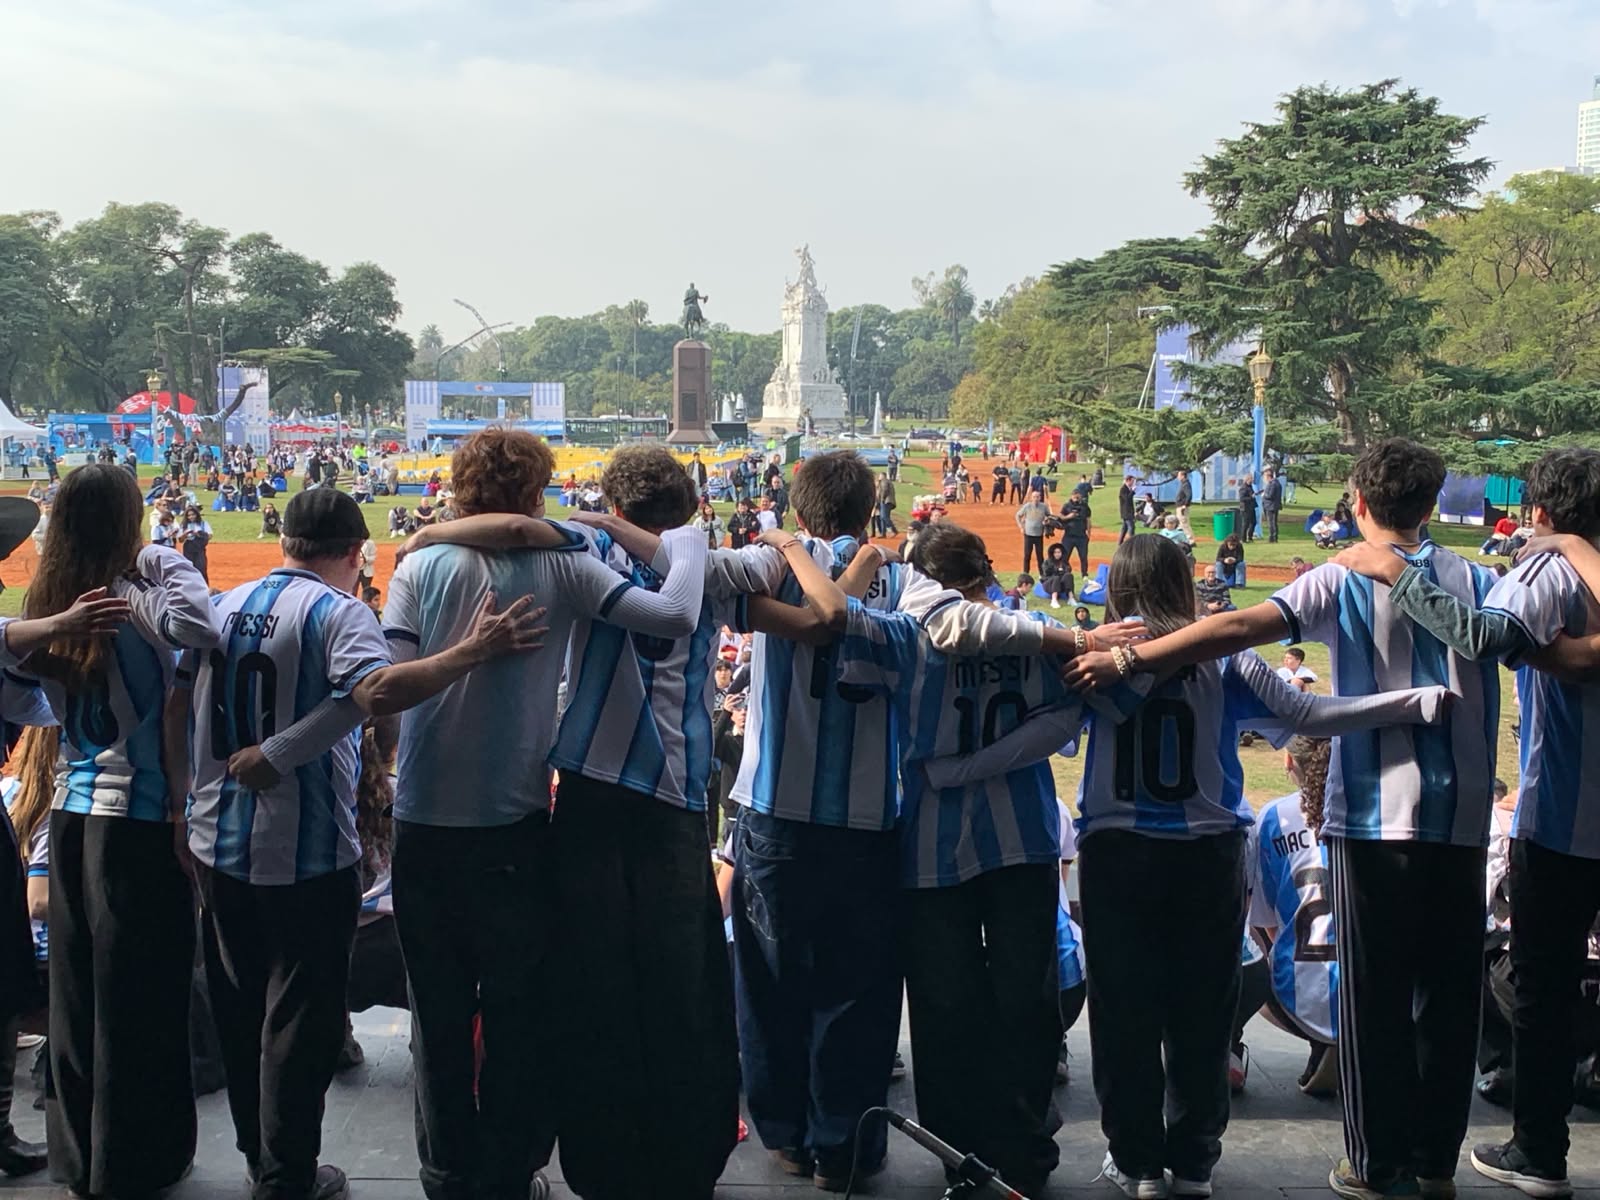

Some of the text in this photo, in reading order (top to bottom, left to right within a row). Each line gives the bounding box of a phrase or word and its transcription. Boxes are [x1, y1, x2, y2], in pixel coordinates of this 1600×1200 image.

[222, 611, 280, 639] MESSI
[209, 647, 277, 761] 10
[953, 690, 1029, 754] 10
[1114, 696, 1199, 803] 10
[1272, 829, 1311, 858] MAC
